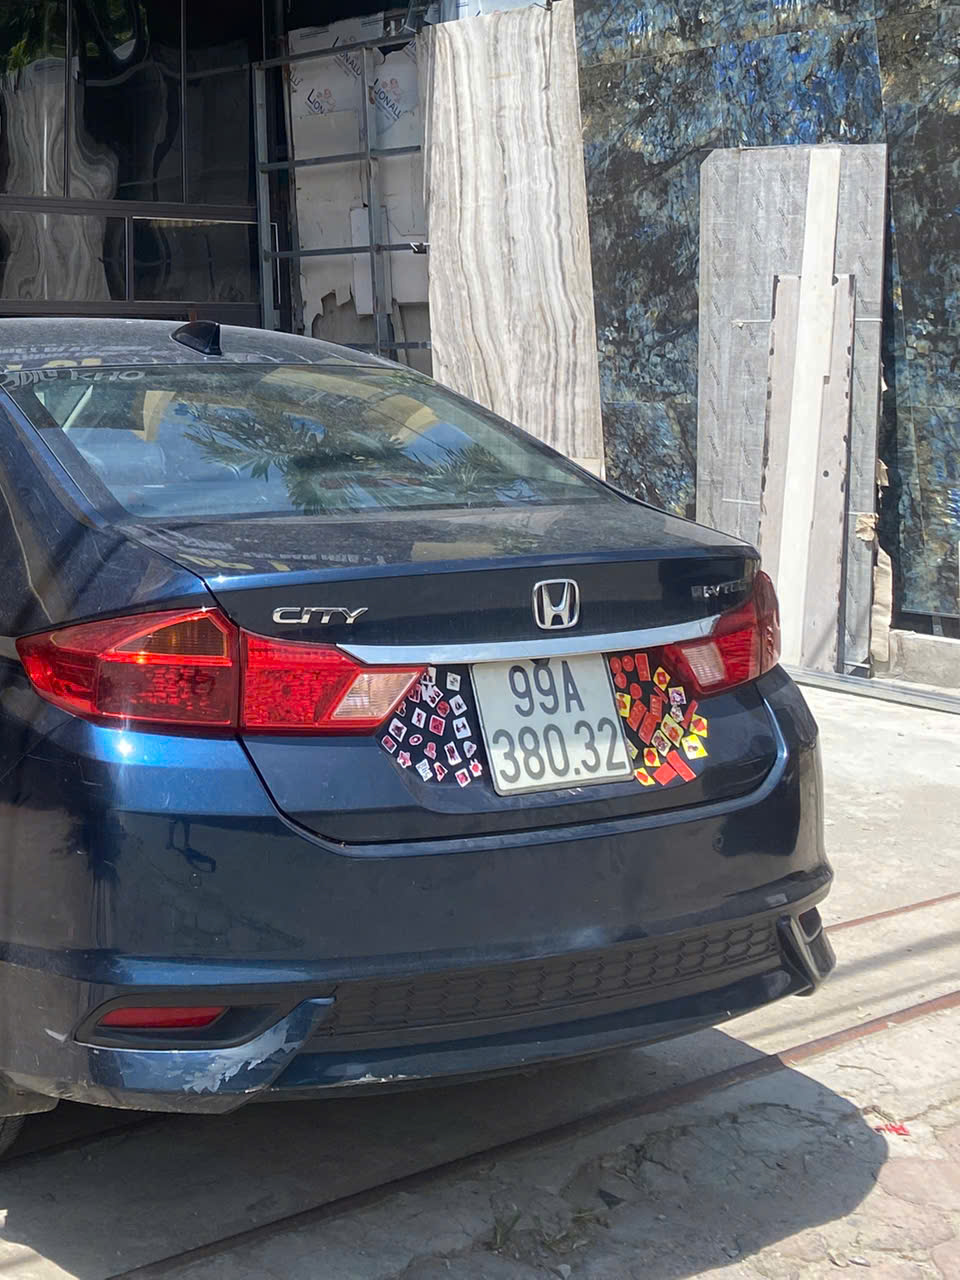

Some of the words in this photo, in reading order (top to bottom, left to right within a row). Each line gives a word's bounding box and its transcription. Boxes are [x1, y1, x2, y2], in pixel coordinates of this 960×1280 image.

[272, 606, 369, 625] CITY
[508, 660, 585, 717] 99A
[492, 717, 627, 783] 380.32
